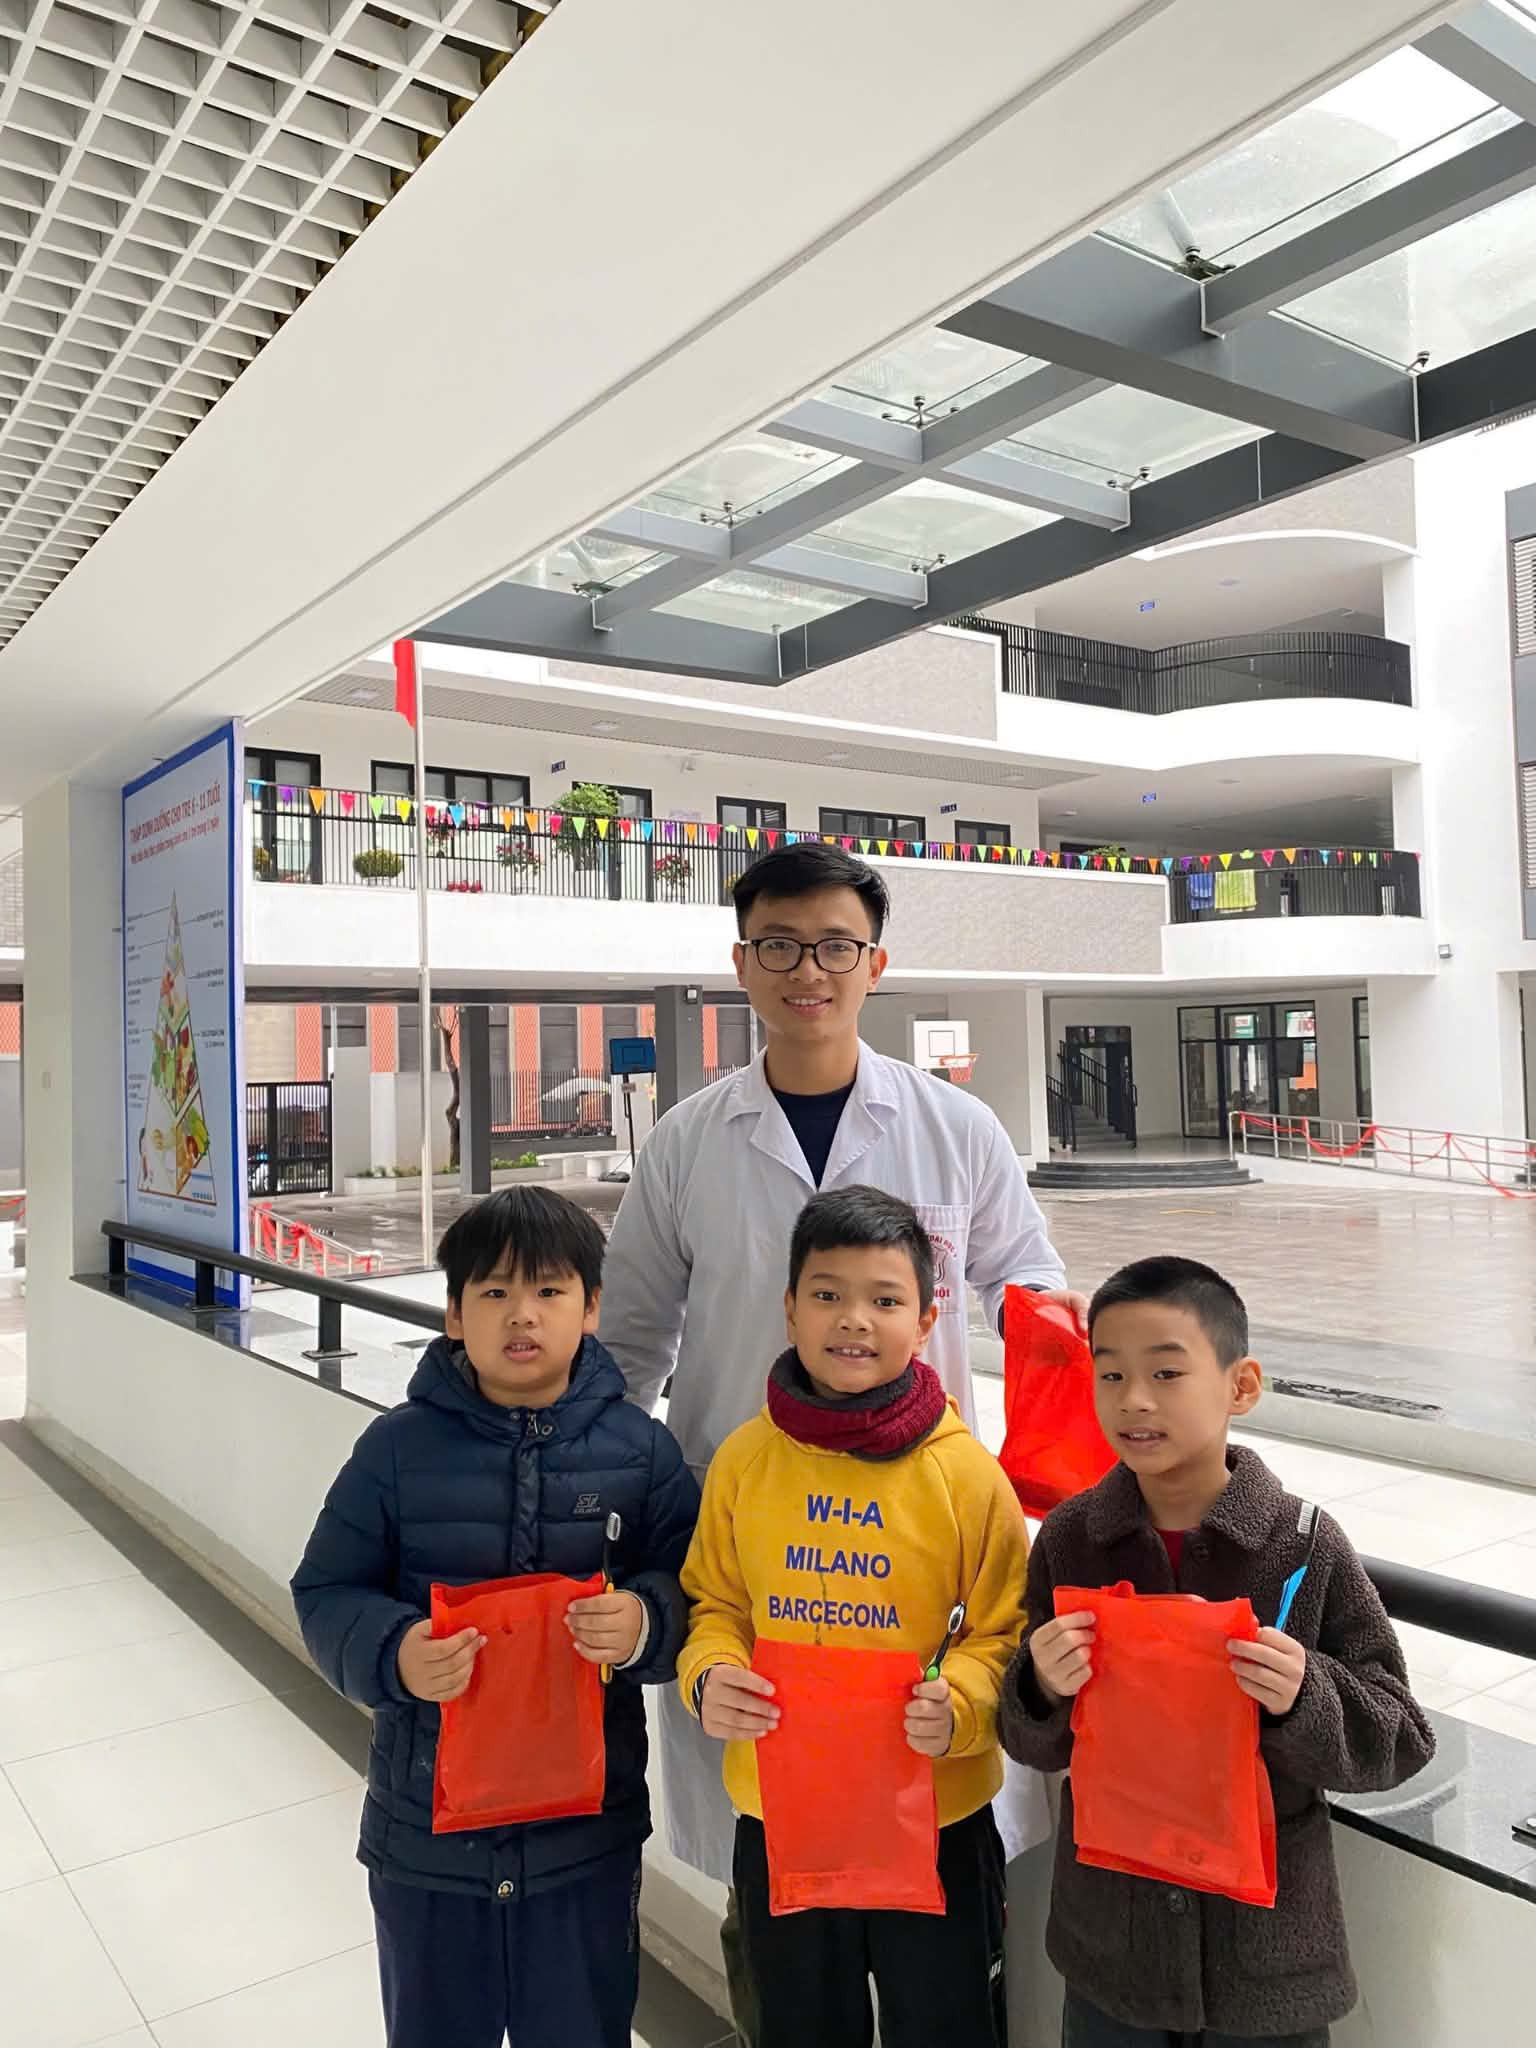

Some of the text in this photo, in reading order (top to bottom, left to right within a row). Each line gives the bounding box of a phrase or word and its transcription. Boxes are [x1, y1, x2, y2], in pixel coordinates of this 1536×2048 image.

[807, 1494, 884, 1528] W-I-A
[785, 1545, 891, 1579] MILANO
[768, 1595, 900, 1629] BARCECONA
